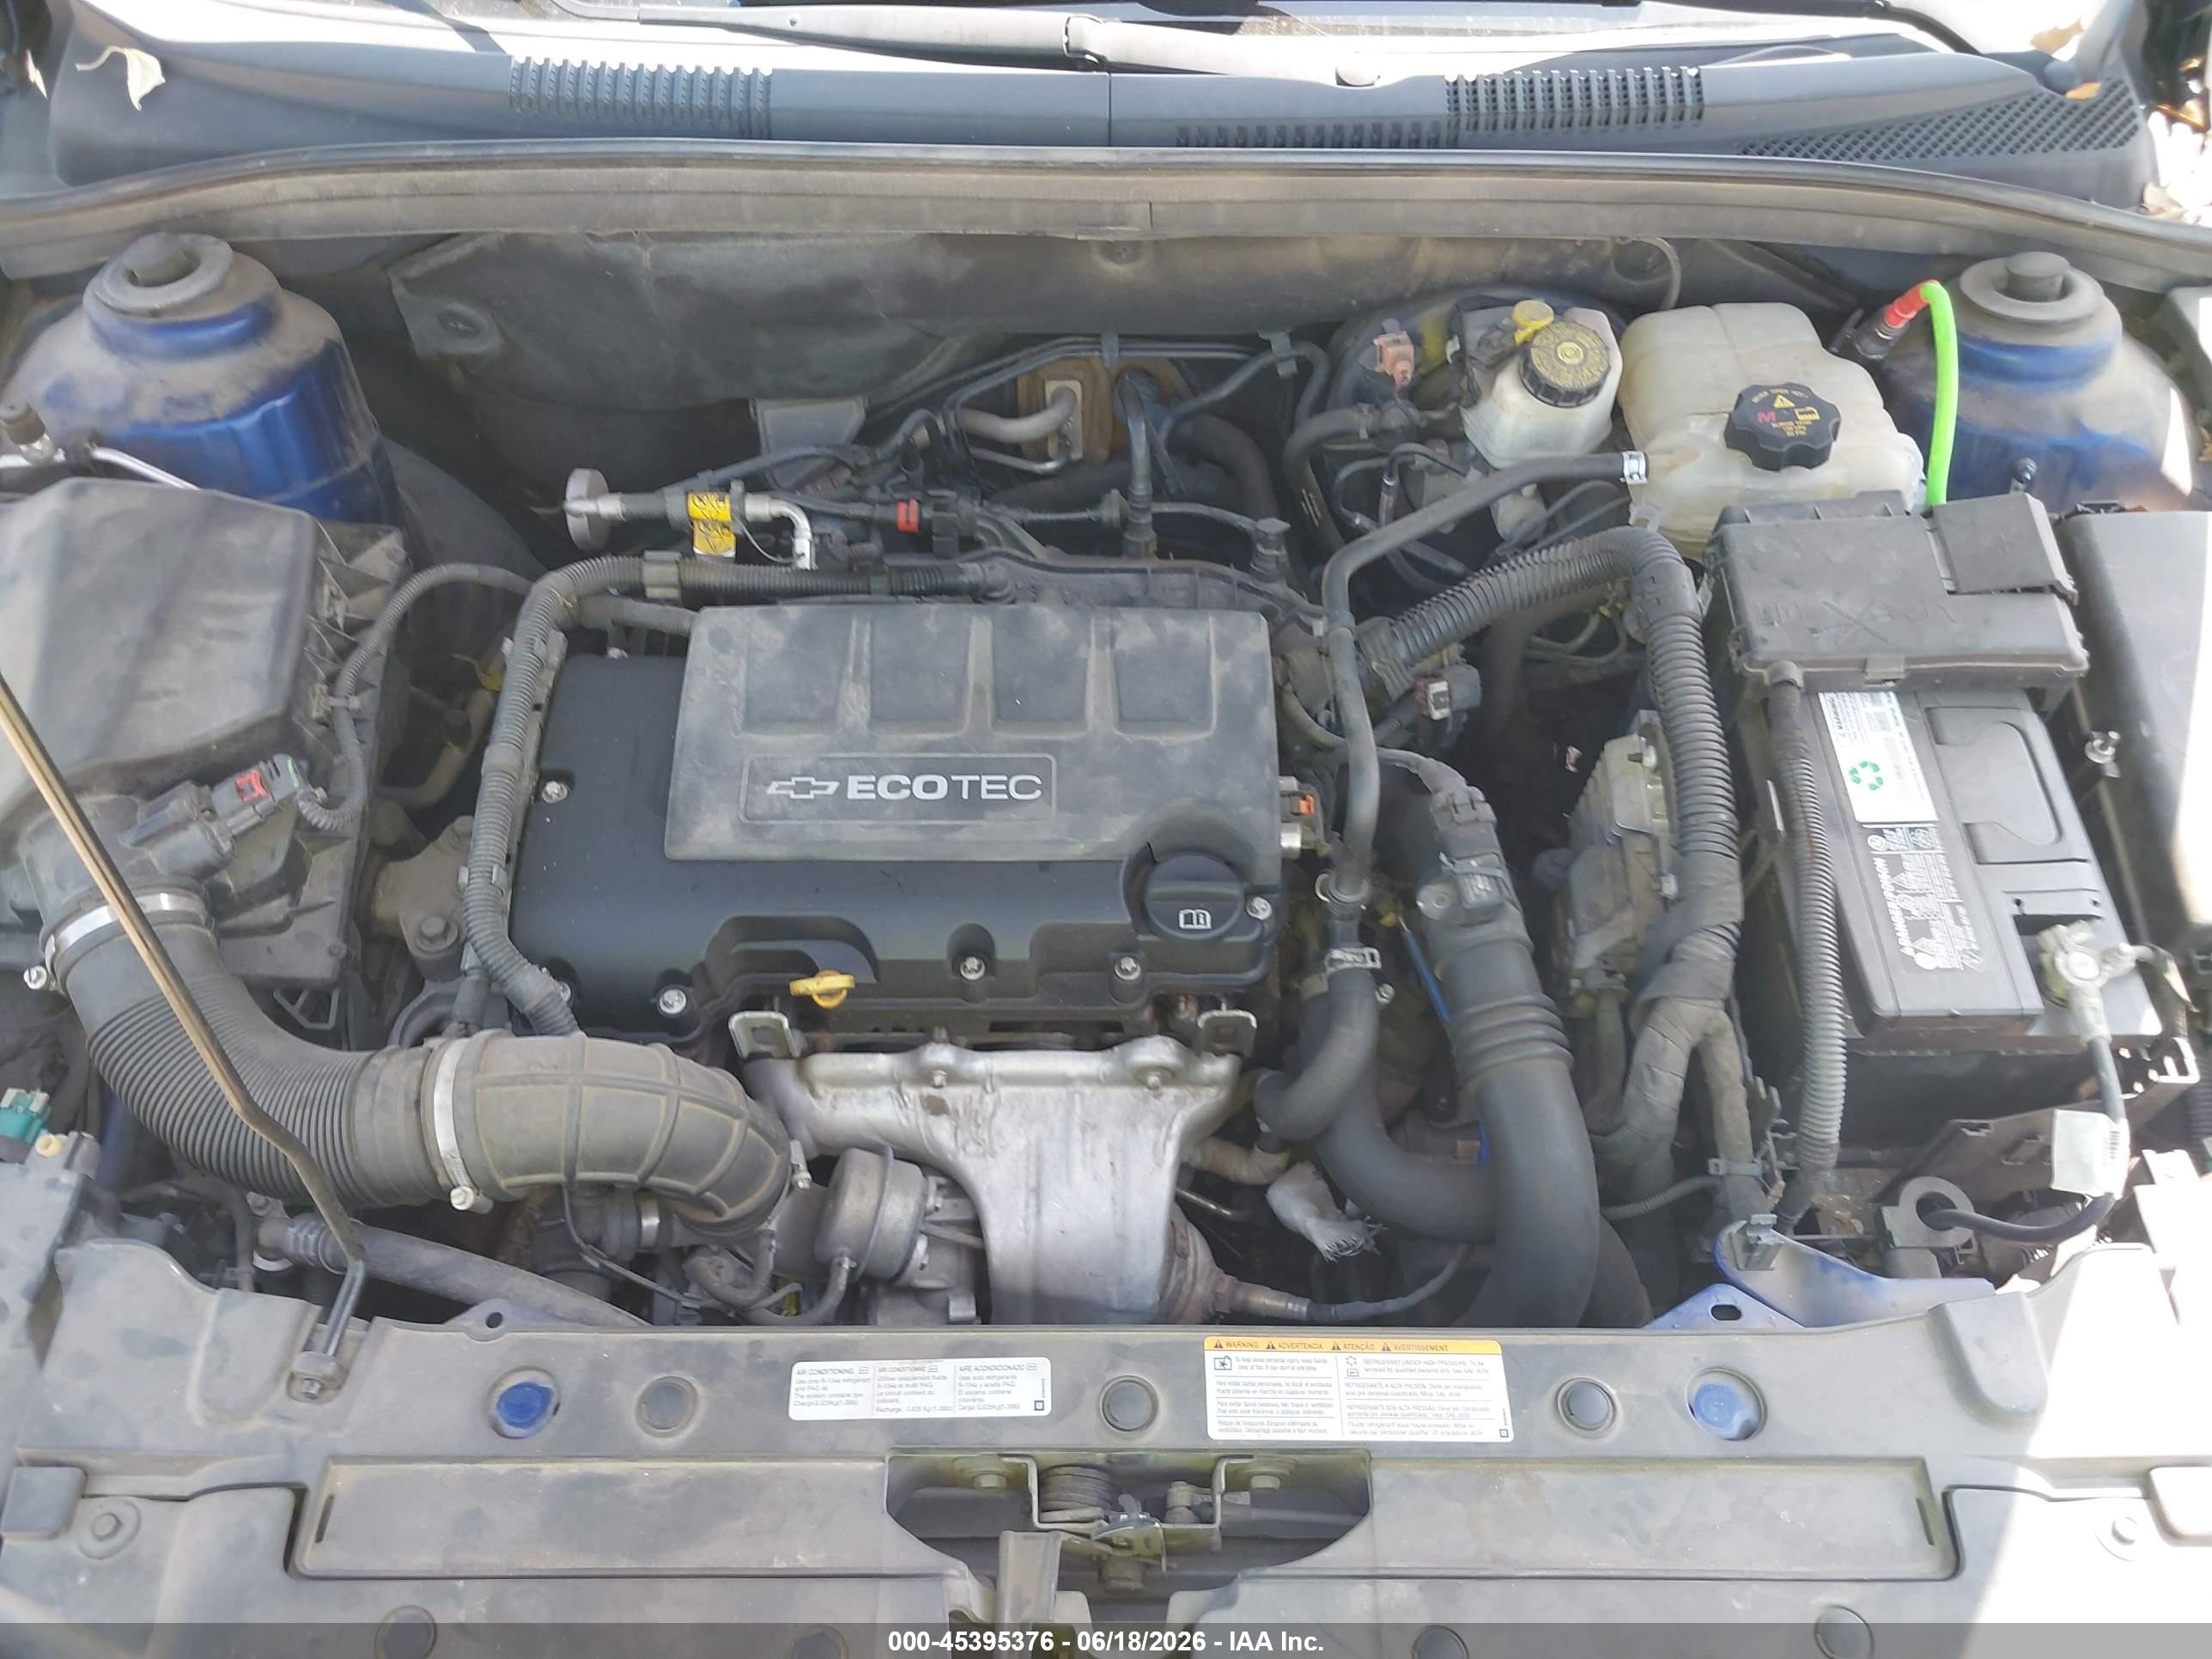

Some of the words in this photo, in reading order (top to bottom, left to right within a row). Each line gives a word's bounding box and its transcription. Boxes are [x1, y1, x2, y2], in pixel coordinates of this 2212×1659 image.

[846, 774, 1042, 801] ECOTEC
[1278, 1341, 1323, 1350] ADVERTENCIA
[1393, 1344, 1449, 1352] AVERTISSEMENT
